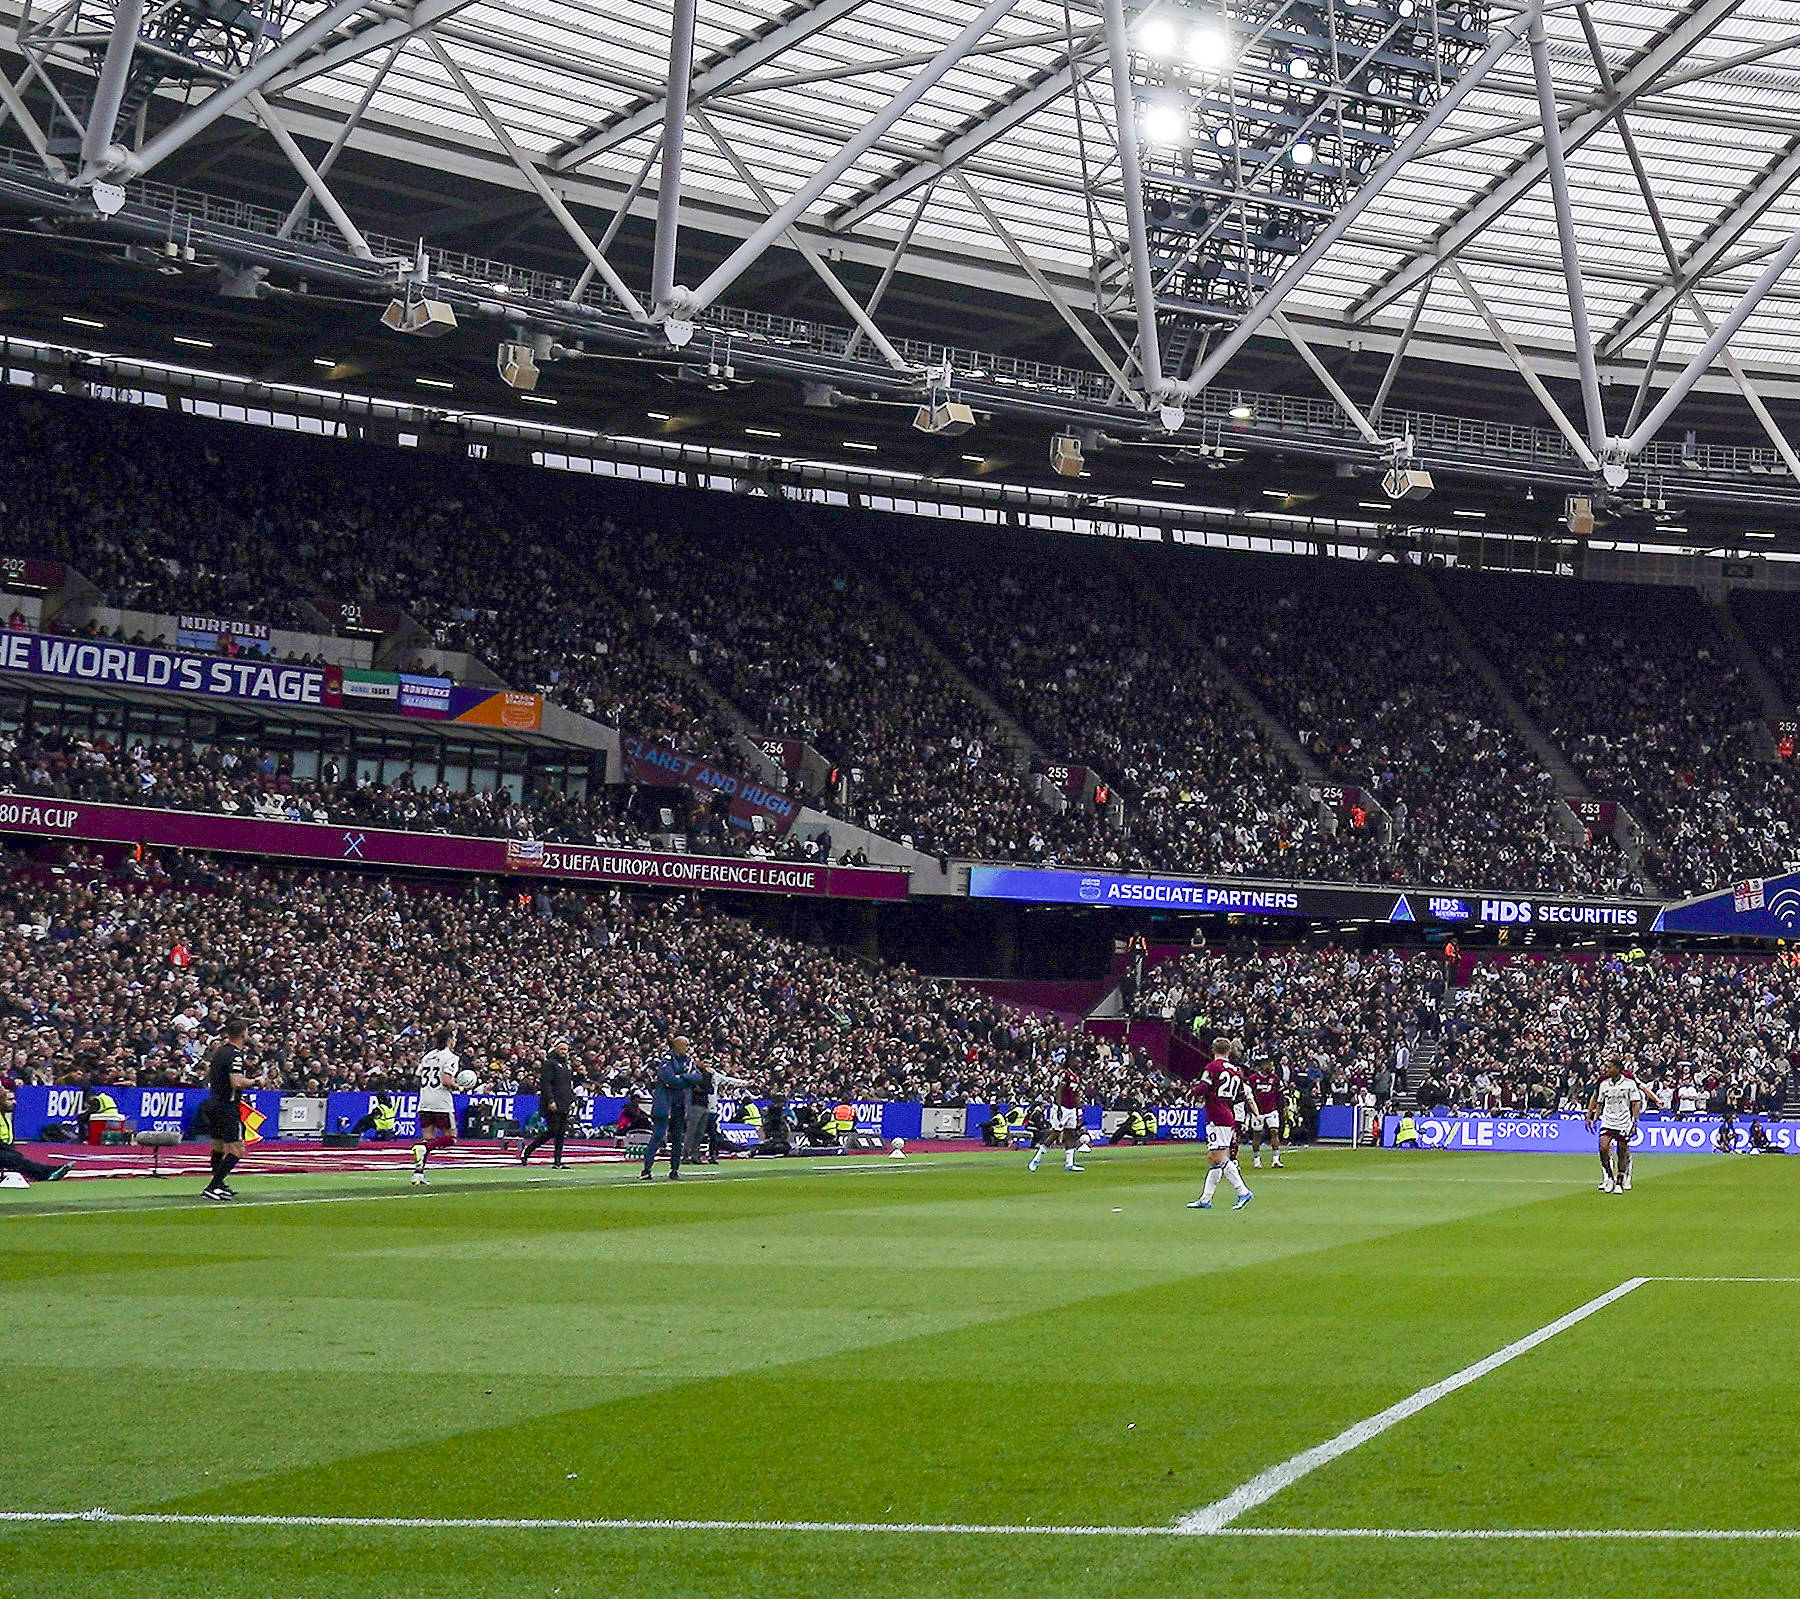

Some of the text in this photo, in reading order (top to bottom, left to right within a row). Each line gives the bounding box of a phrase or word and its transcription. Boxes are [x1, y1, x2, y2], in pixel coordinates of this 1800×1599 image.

[2, 558, 25, 571] 202
[341, 604, 361, 616] 201
[180, 615, 268, 638] NORFOLK
[40, 640, 202, 690] WORLD'S
[209, 662, 323, 703] STAGE
[1779, 722, 1798, 732] 252
[762, 741, 784, 754] 256
[625, 737, 793, 817] CLARET AND HUGH
[1048, 767, 1068, 778] 255
[1323, 787, 1343, 798] 254
[22, 807, 41, 826] FA
[44, 809, 78, 828] CUP
[1580, 803, 1600, 814] 253
[562, 853, 599, 872] UEFA
[603, 856, 659, 877] EUROPA
[662, 861, 757, 884] CONFERENCE
[760, 868, 815, 888] LEAGUE
[1108, 882, 1298, 909] ASSOCIATE PARTNERS
[1429, 898, 1459, 911] HDS
[1481, 901, 1637, 925] HDS SECURITIES
[421, 1067, 441, 1088] 33
[1217, 1074, 1241, 1100] 20
[47, 1091, 84, 1117] BOYL
[141, 1092, 184, 1118] BOYLE
[1158, 1109, 1198, 1126] BOYLE
[1417, 1120, 1559, 1147] OYLE SPORTS
[1648, 1127, 1706, 1147] TWO
